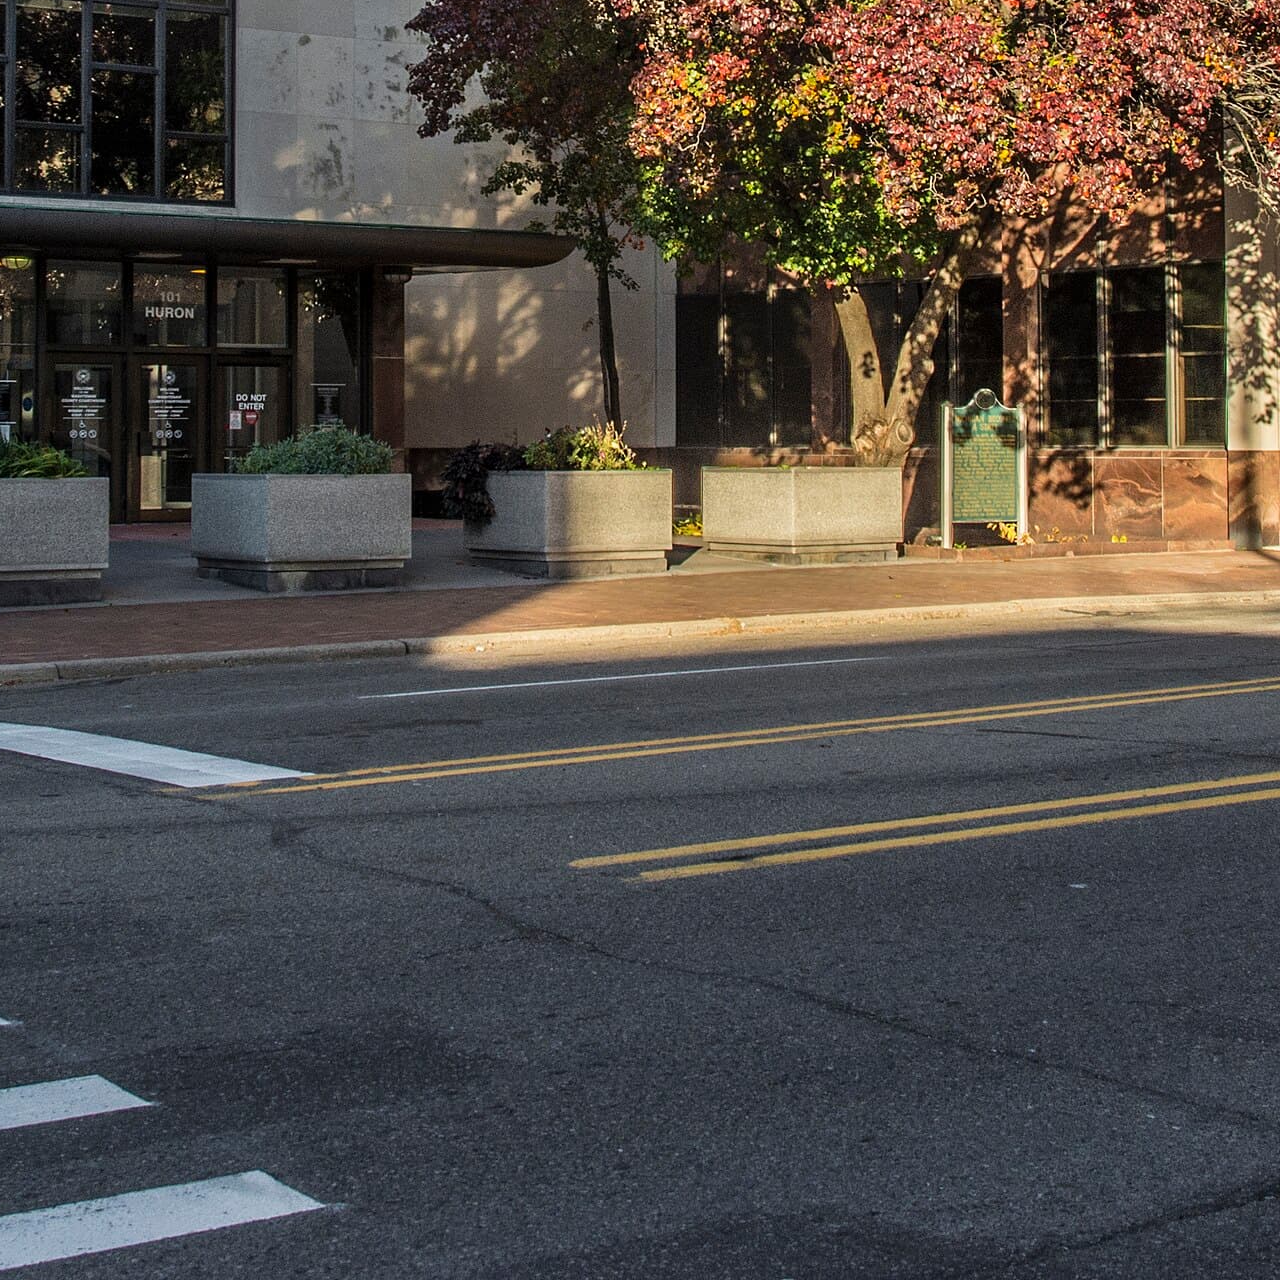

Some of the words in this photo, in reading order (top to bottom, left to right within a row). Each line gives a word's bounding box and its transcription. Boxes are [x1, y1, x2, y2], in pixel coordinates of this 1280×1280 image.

[159, 291, 181, 302] 101
[145, 306, 195, 319] HURON
[235, 393, 248, 401] DO
[250, 394, 267, 402] NOT
[238, 402, 265, 410] ENTER
